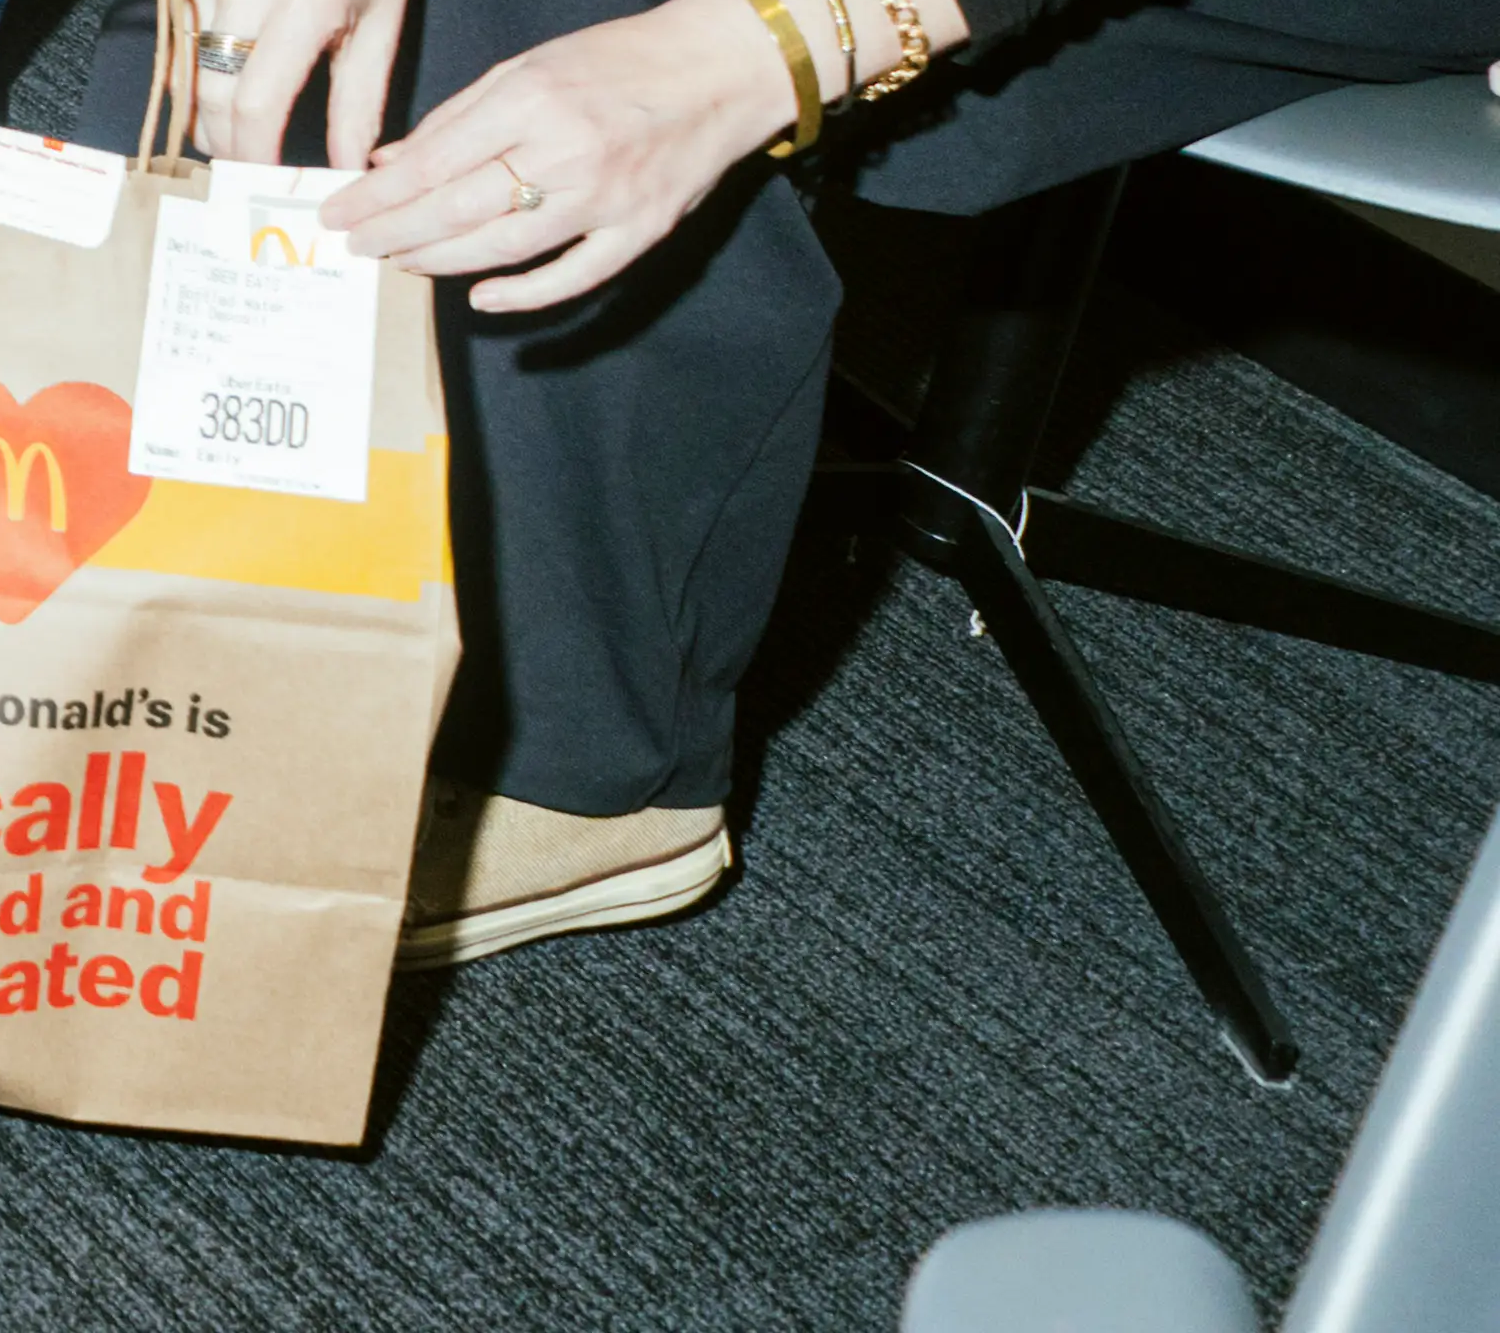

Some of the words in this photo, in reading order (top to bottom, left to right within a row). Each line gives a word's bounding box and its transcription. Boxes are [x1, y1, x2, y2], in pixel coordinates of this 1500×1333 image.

[198, 391, 310, 450] 383DD
[185, 692, 232, 740] is
[60, 880, 211, 943] and
